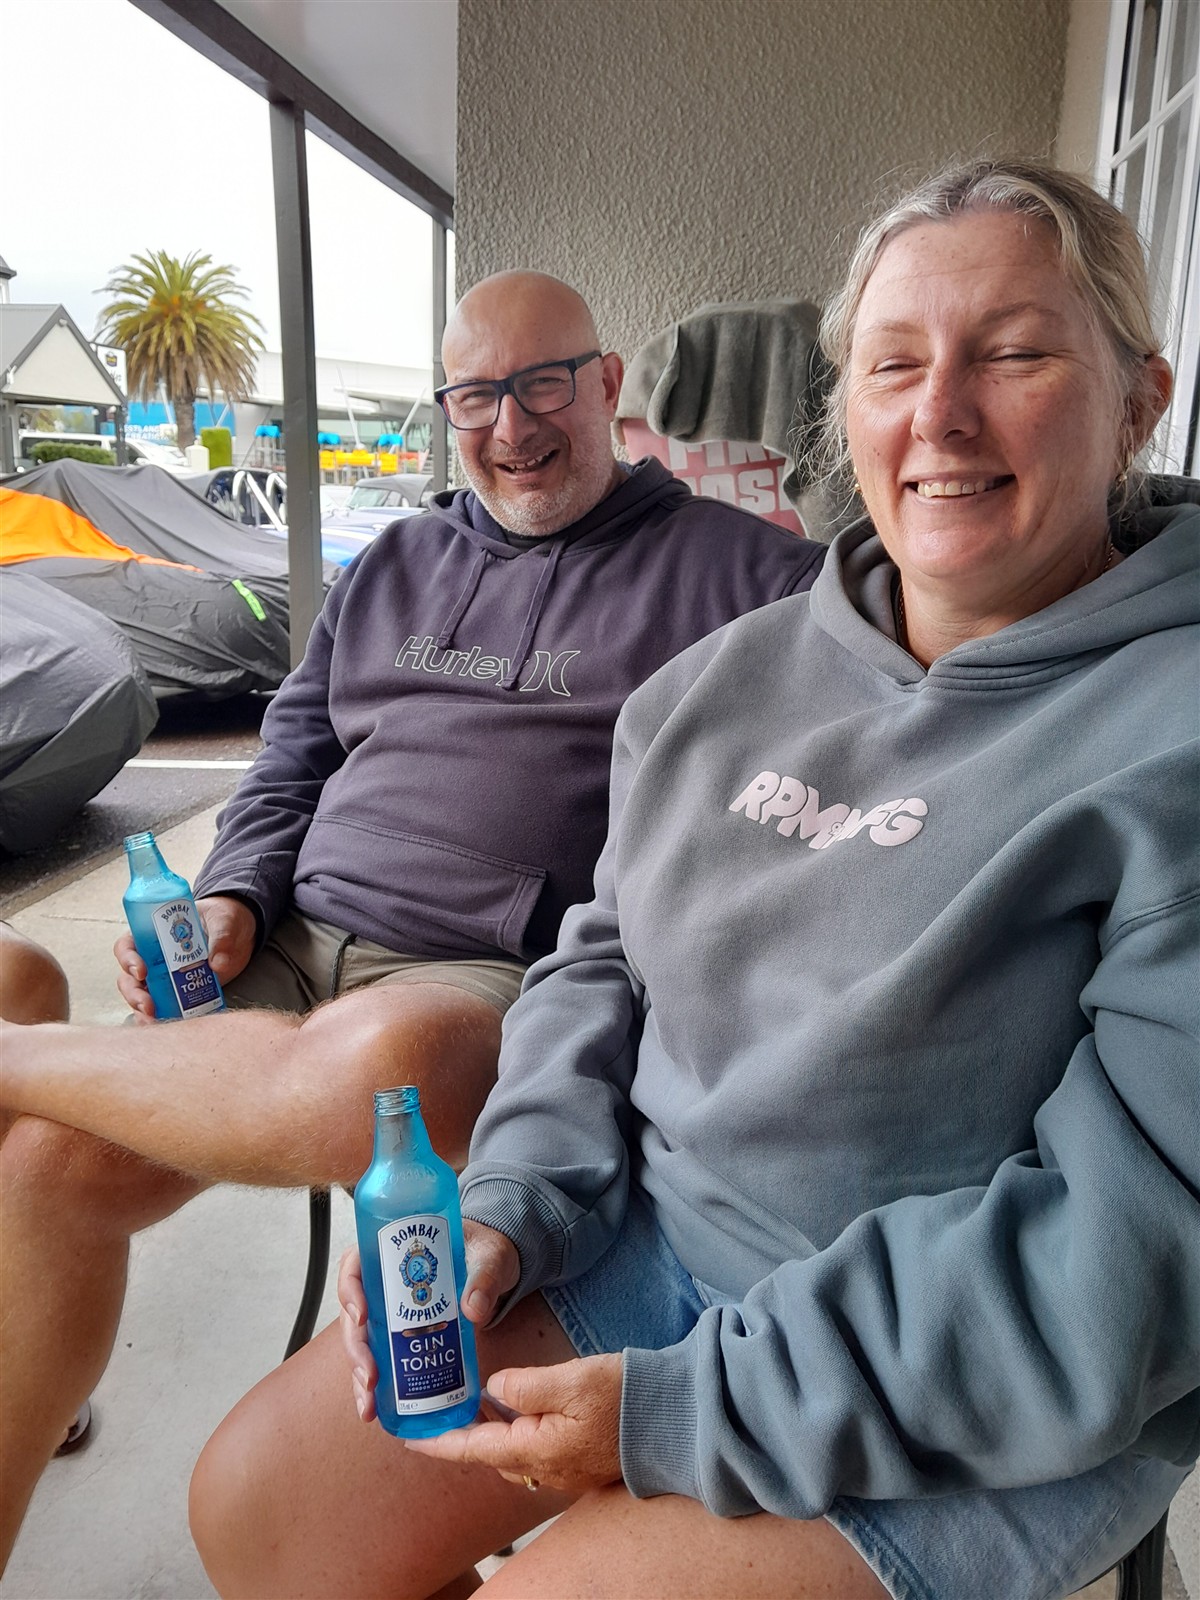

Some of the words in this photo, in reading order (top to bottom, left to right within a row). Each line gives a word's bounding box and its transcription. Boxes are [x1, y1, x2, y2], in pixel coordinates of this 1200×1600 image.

[395, 635, 530, 686] Hurley
[161, 905, 190, 921] BOMBAY
[173, 944, 205, 962] SAPPHIRE
[180, 974, 214, 994] TONIC
[185, 967, 206, 981] GIN
[390, 1223, 441, 1250] BOMBAY
[396, 1293, 451, 1322] SAPPHIRE
[409, 1334, 444, 1353] GIN
[400, 1349, 456, 1372] TONIC
